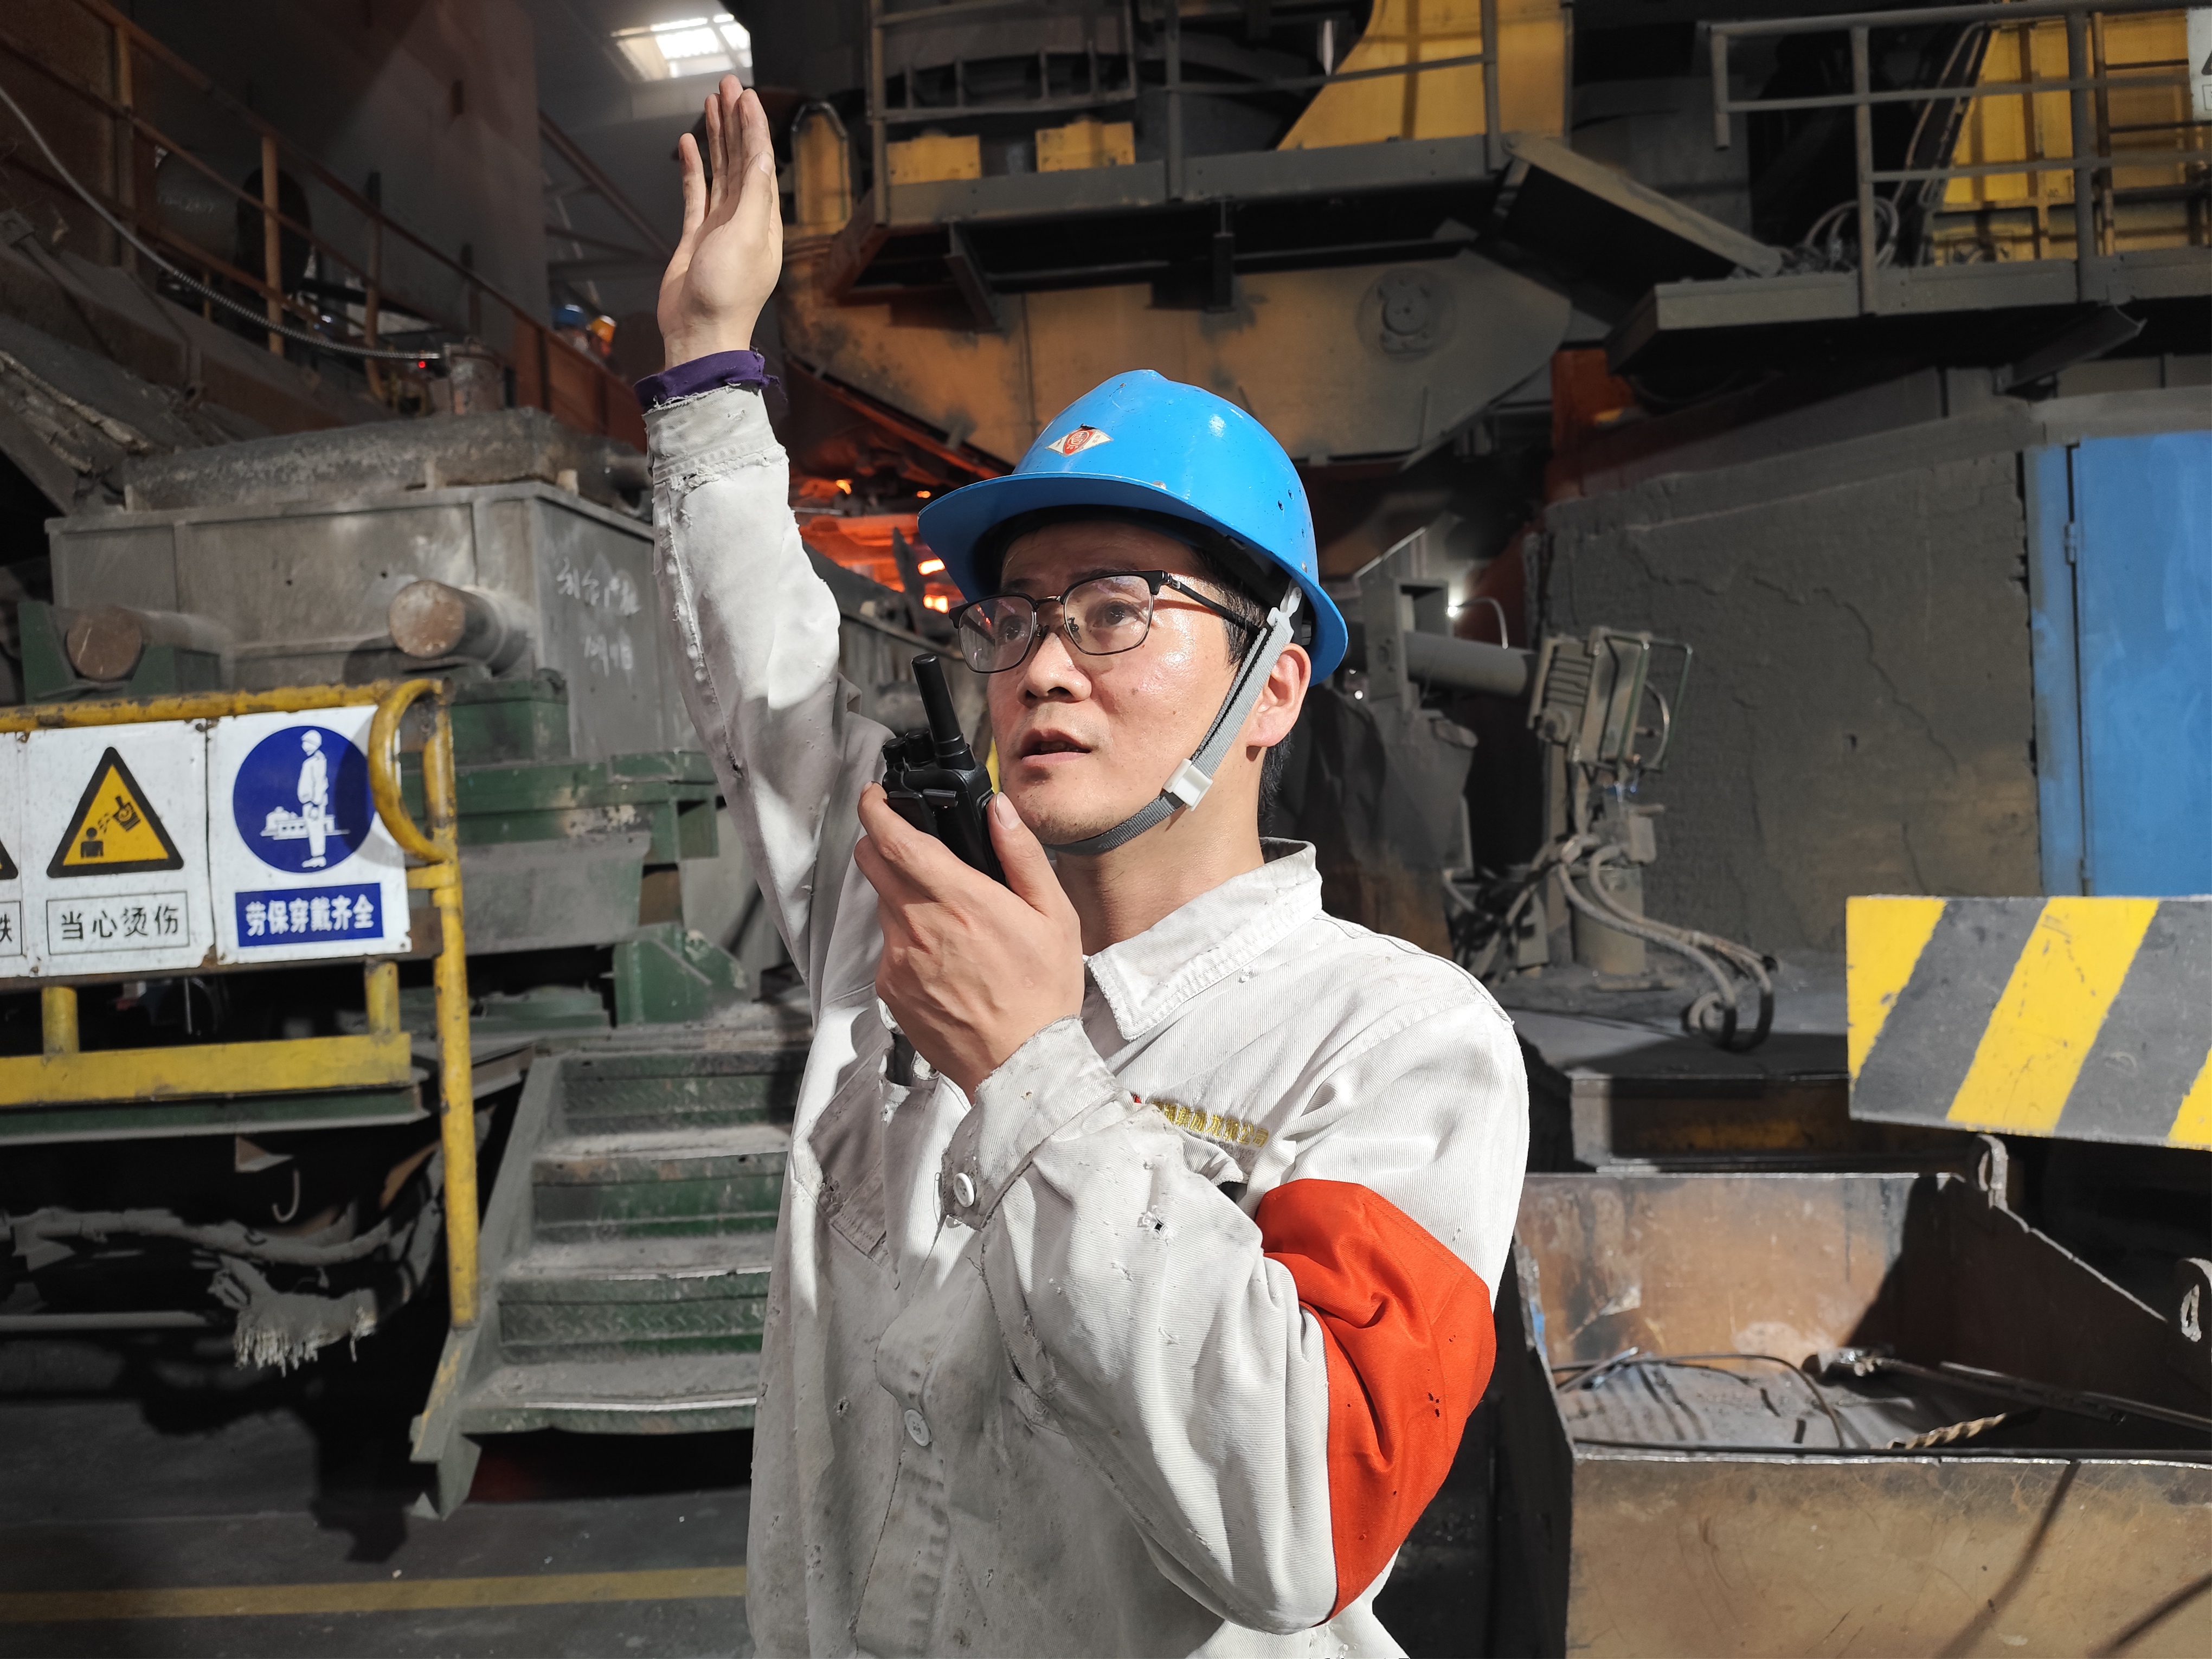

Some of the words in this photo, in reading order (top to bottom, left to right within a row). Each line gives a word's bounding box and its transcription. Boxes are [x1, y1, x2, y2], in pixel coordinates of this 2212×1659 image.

[61, 905, 179, 941] 当心烫伤
[245, 894, 374, 936] 劳保穿戴齐全
[1152, 1101, 1269, 1147] 钢集团龙钢公司
